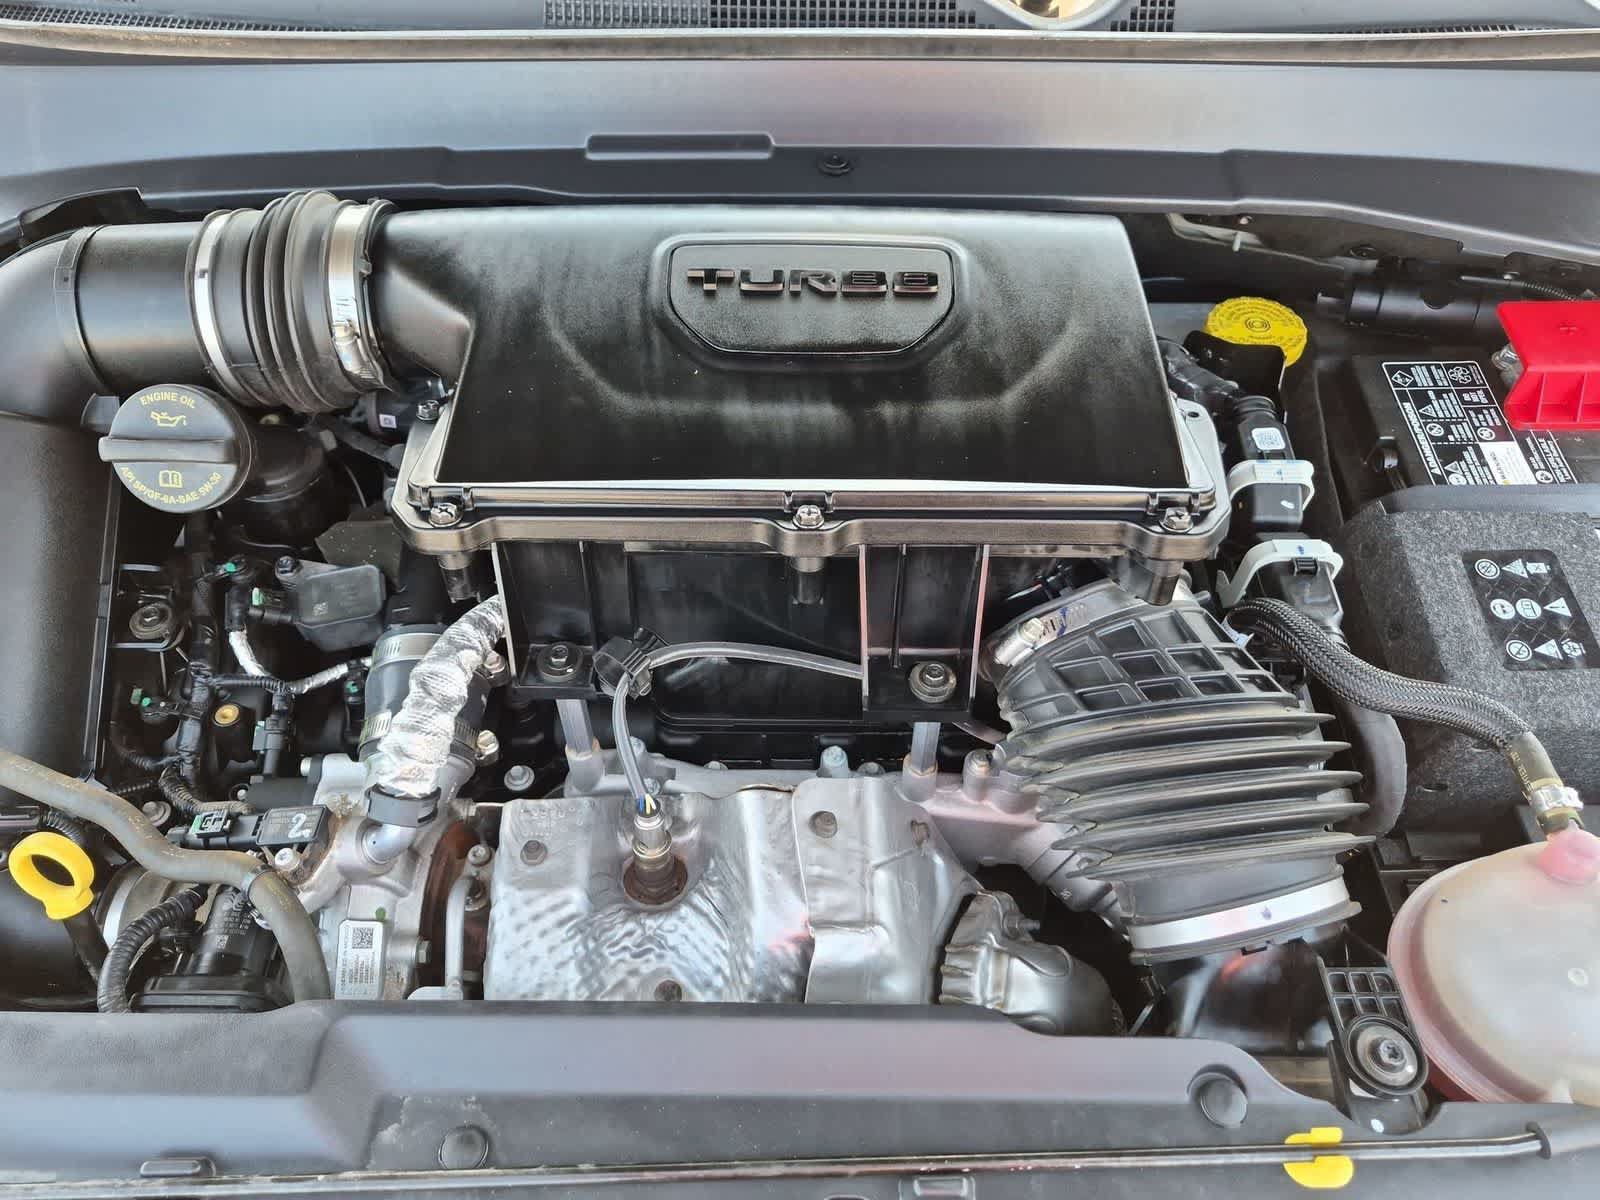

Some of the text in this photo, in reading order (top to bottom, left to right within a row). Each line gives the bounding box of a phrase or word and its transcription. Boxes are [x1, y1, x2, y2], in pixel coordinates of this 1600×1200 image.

[687, 268, 939, 295] TURBO
[140, 391, 196, 409] ENGINE OIL
